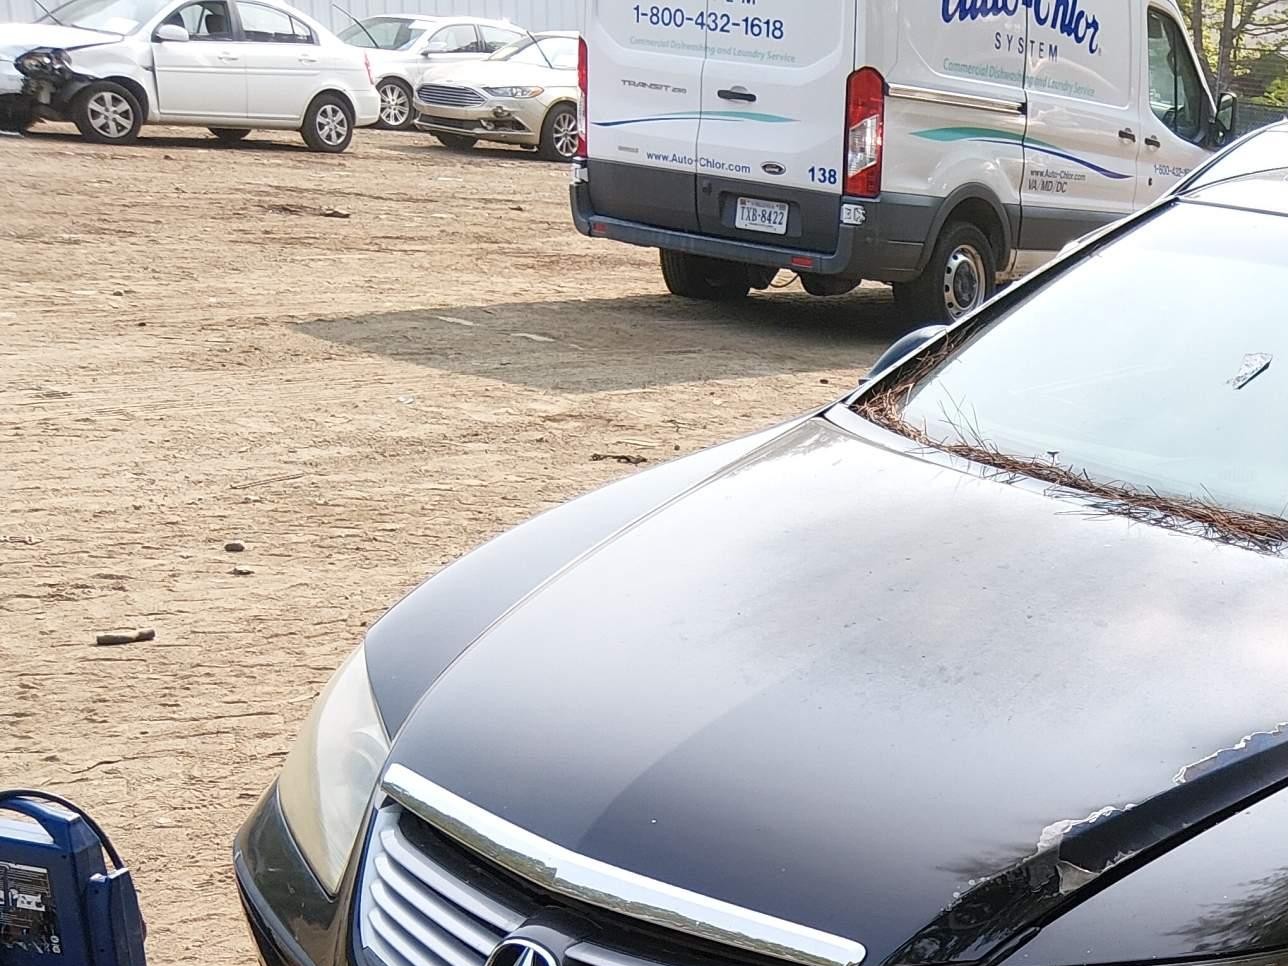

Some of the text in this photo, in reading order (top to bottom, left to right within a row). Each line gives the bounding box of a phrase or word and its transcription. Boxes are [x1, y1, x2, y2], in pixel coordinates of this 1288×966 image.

[632, 4, 785, 40] 1-800-432-1618
[994, 32, 1059, 62] SYSTEM
[646, 150, 751, 174] www.Auto-Chlor.com
[808, 166, 838, 185] 138
